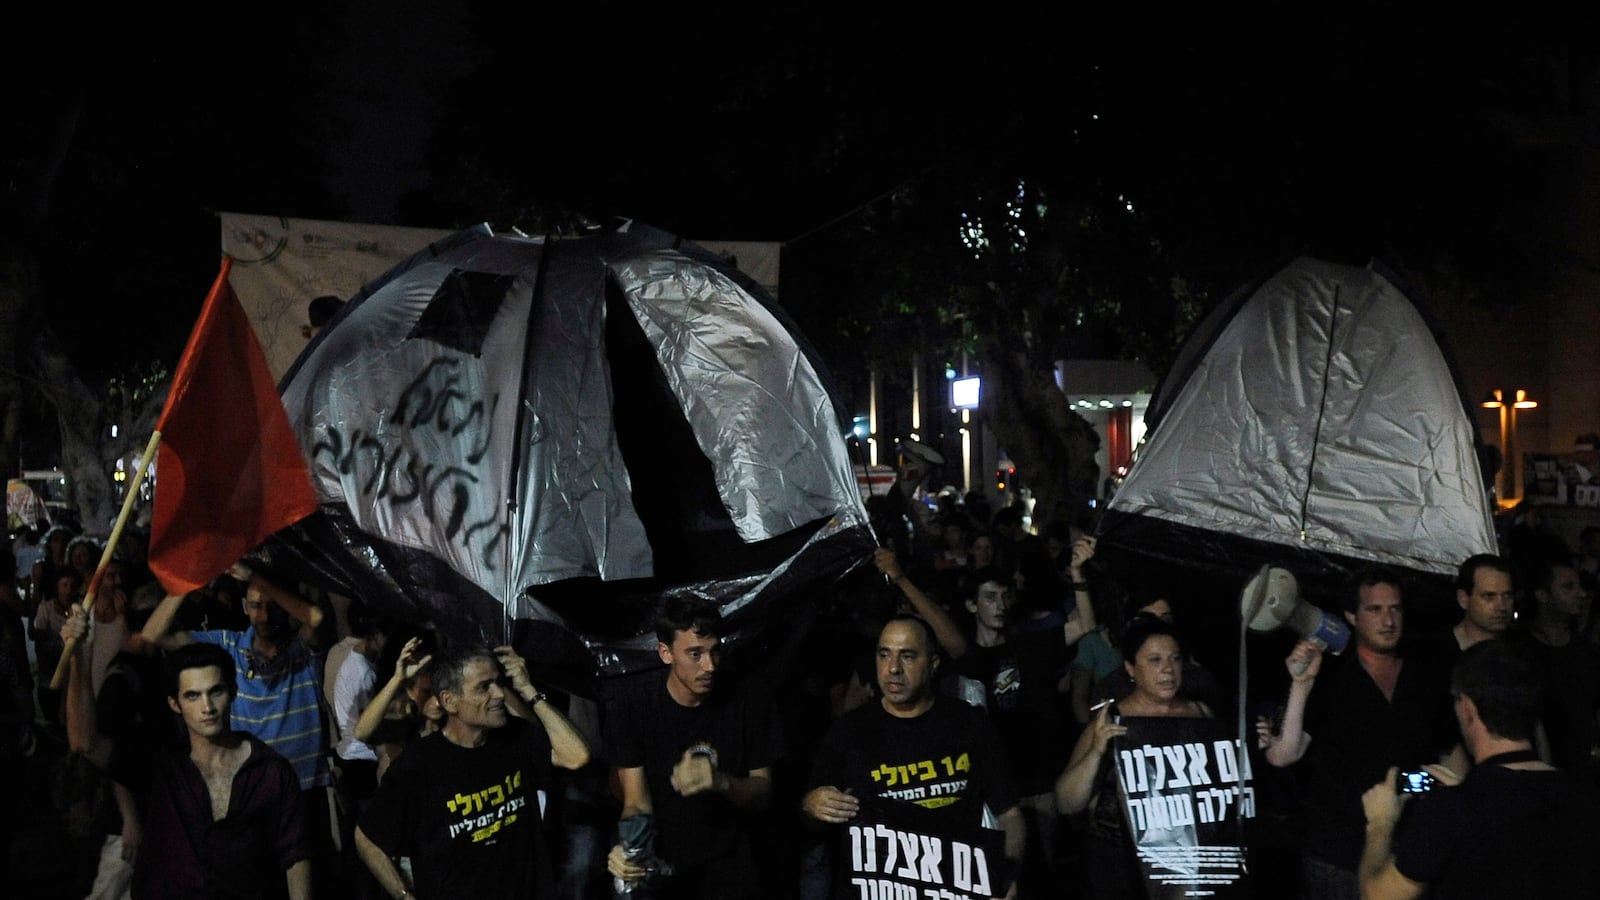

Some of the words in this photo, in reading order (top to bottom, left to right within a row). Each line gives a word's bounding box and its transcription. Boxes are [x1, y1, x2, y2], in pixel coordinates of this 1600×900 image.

[870, 759, 938, 787] ביולי
[940, 752, 972, 776] 14
[1120, 743, 1213, 794] אצלנו
[446, 784, 506, 817] ביולי
[848, 823, 944, 884] אצלנו
[951, 841, 993, 897] גם
